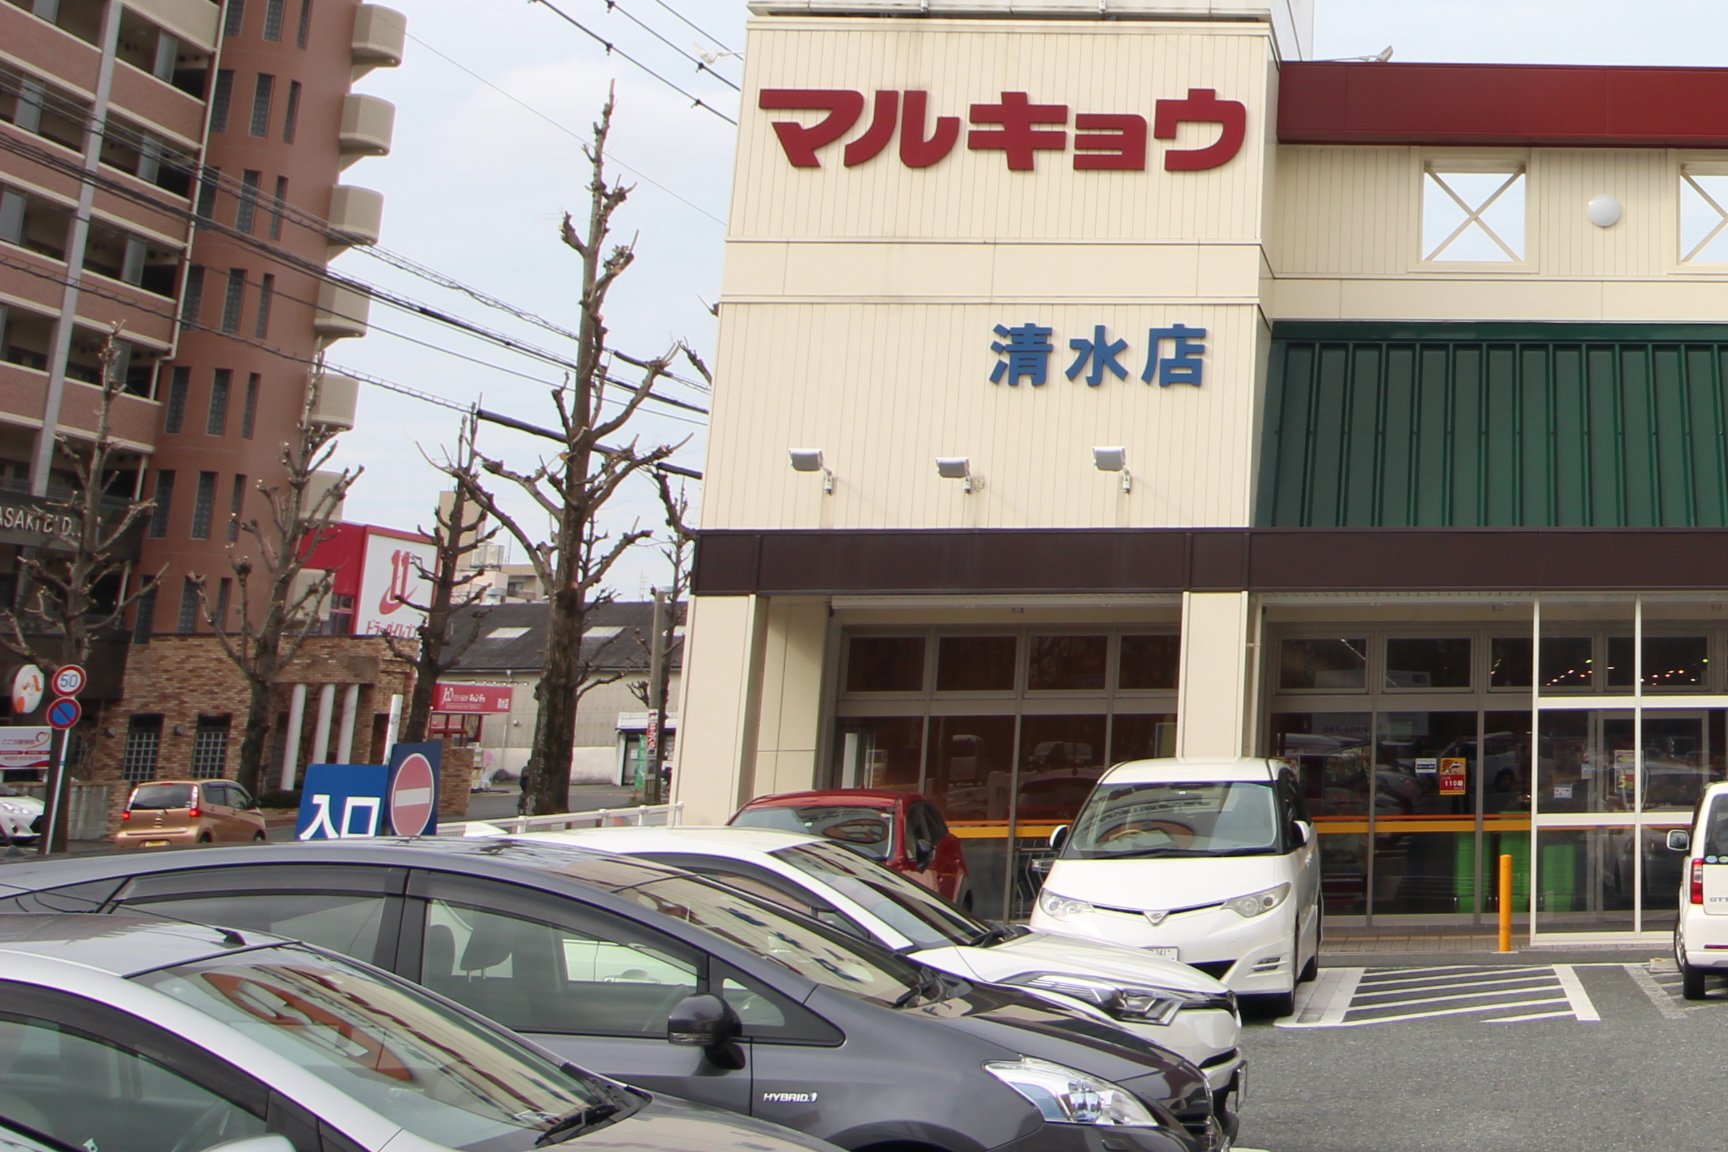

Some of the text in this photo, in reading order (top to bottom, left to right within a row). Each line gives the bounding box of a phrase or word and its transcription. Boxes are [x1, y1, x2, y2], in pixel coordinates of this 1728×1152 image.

[759, 88, 1247, 171] マルキョウ
[990, 323, 1207, 387] 清水店
[60, 673, 79, 688] 50
[299, 794, 381, 840] 入口
